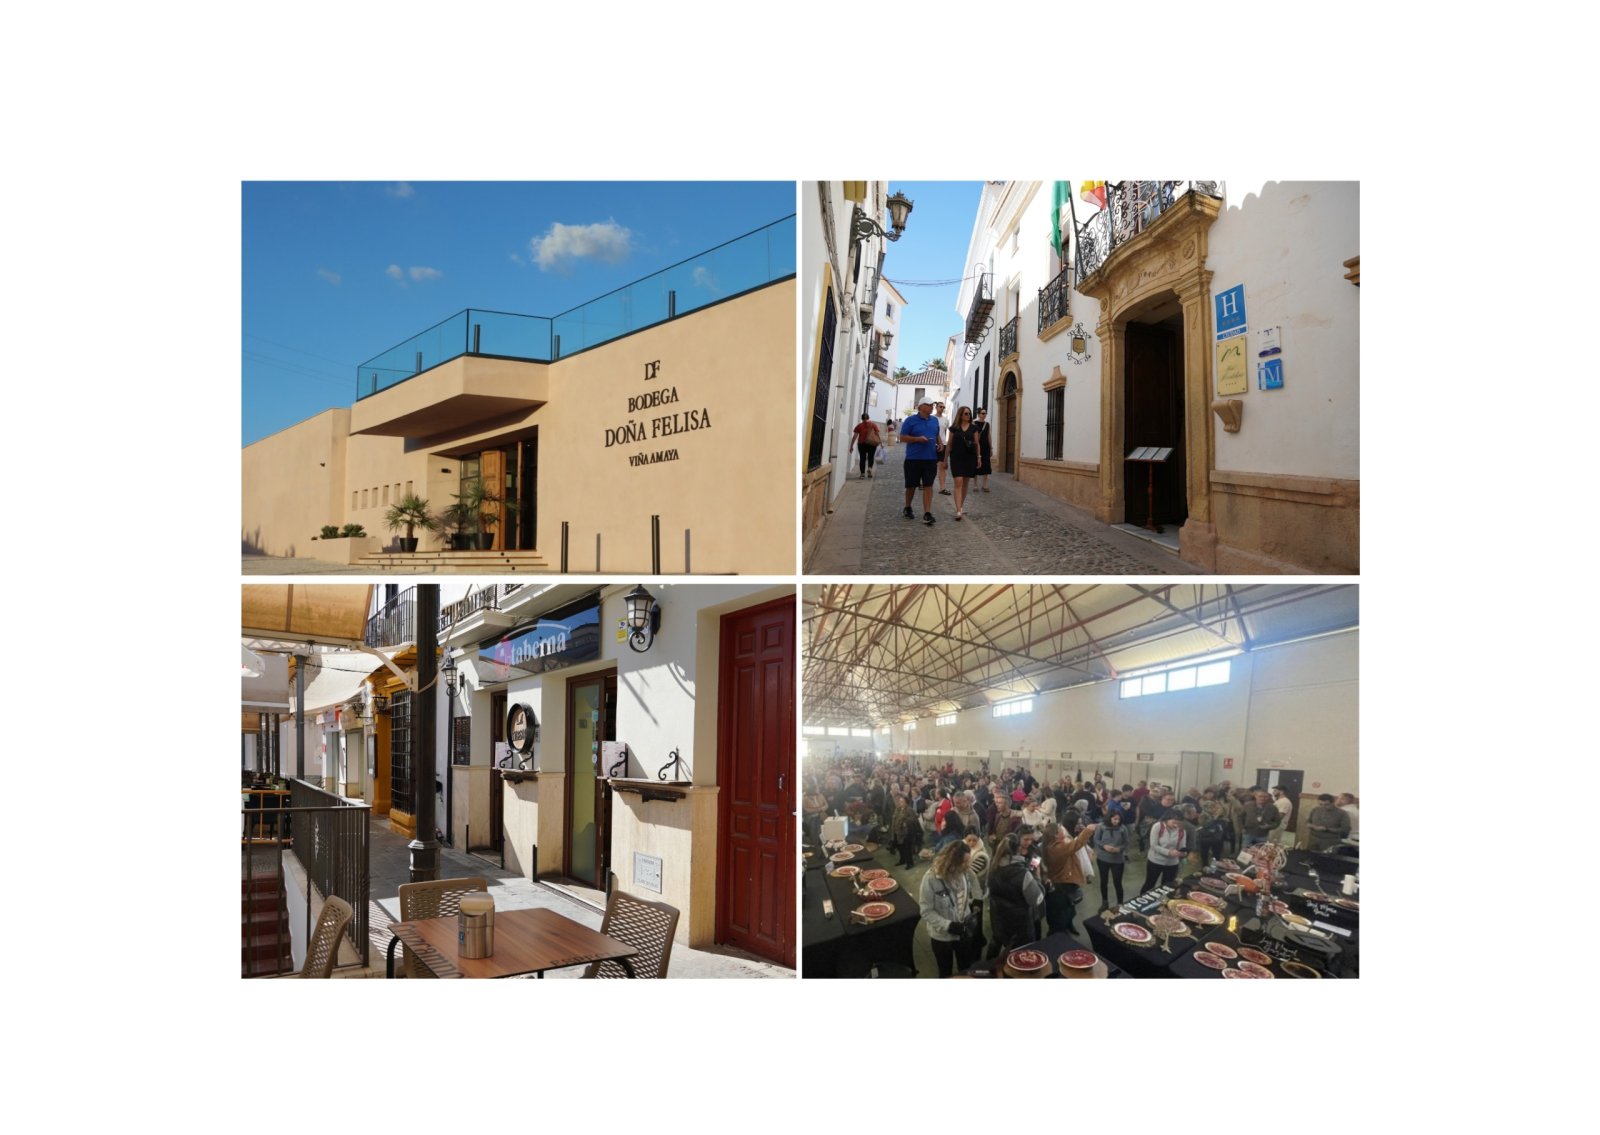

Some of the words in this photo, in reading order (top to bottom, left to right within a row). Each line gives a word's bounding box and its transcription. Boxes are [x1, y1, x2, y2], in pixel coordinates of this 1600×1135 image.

[1221, 291, 1238, 318] H
[644, 360, 661, 380] DF
[628, 386, 680, 413] BODEGA
[605, 420, 647, 447] DOÑA
[651, 407, 712, 439] FELISA
[629, 452, 649, 467] VIÑA
[650, 448, 680, 464] AMAYA
[511, 632, 566, 666] taberna
